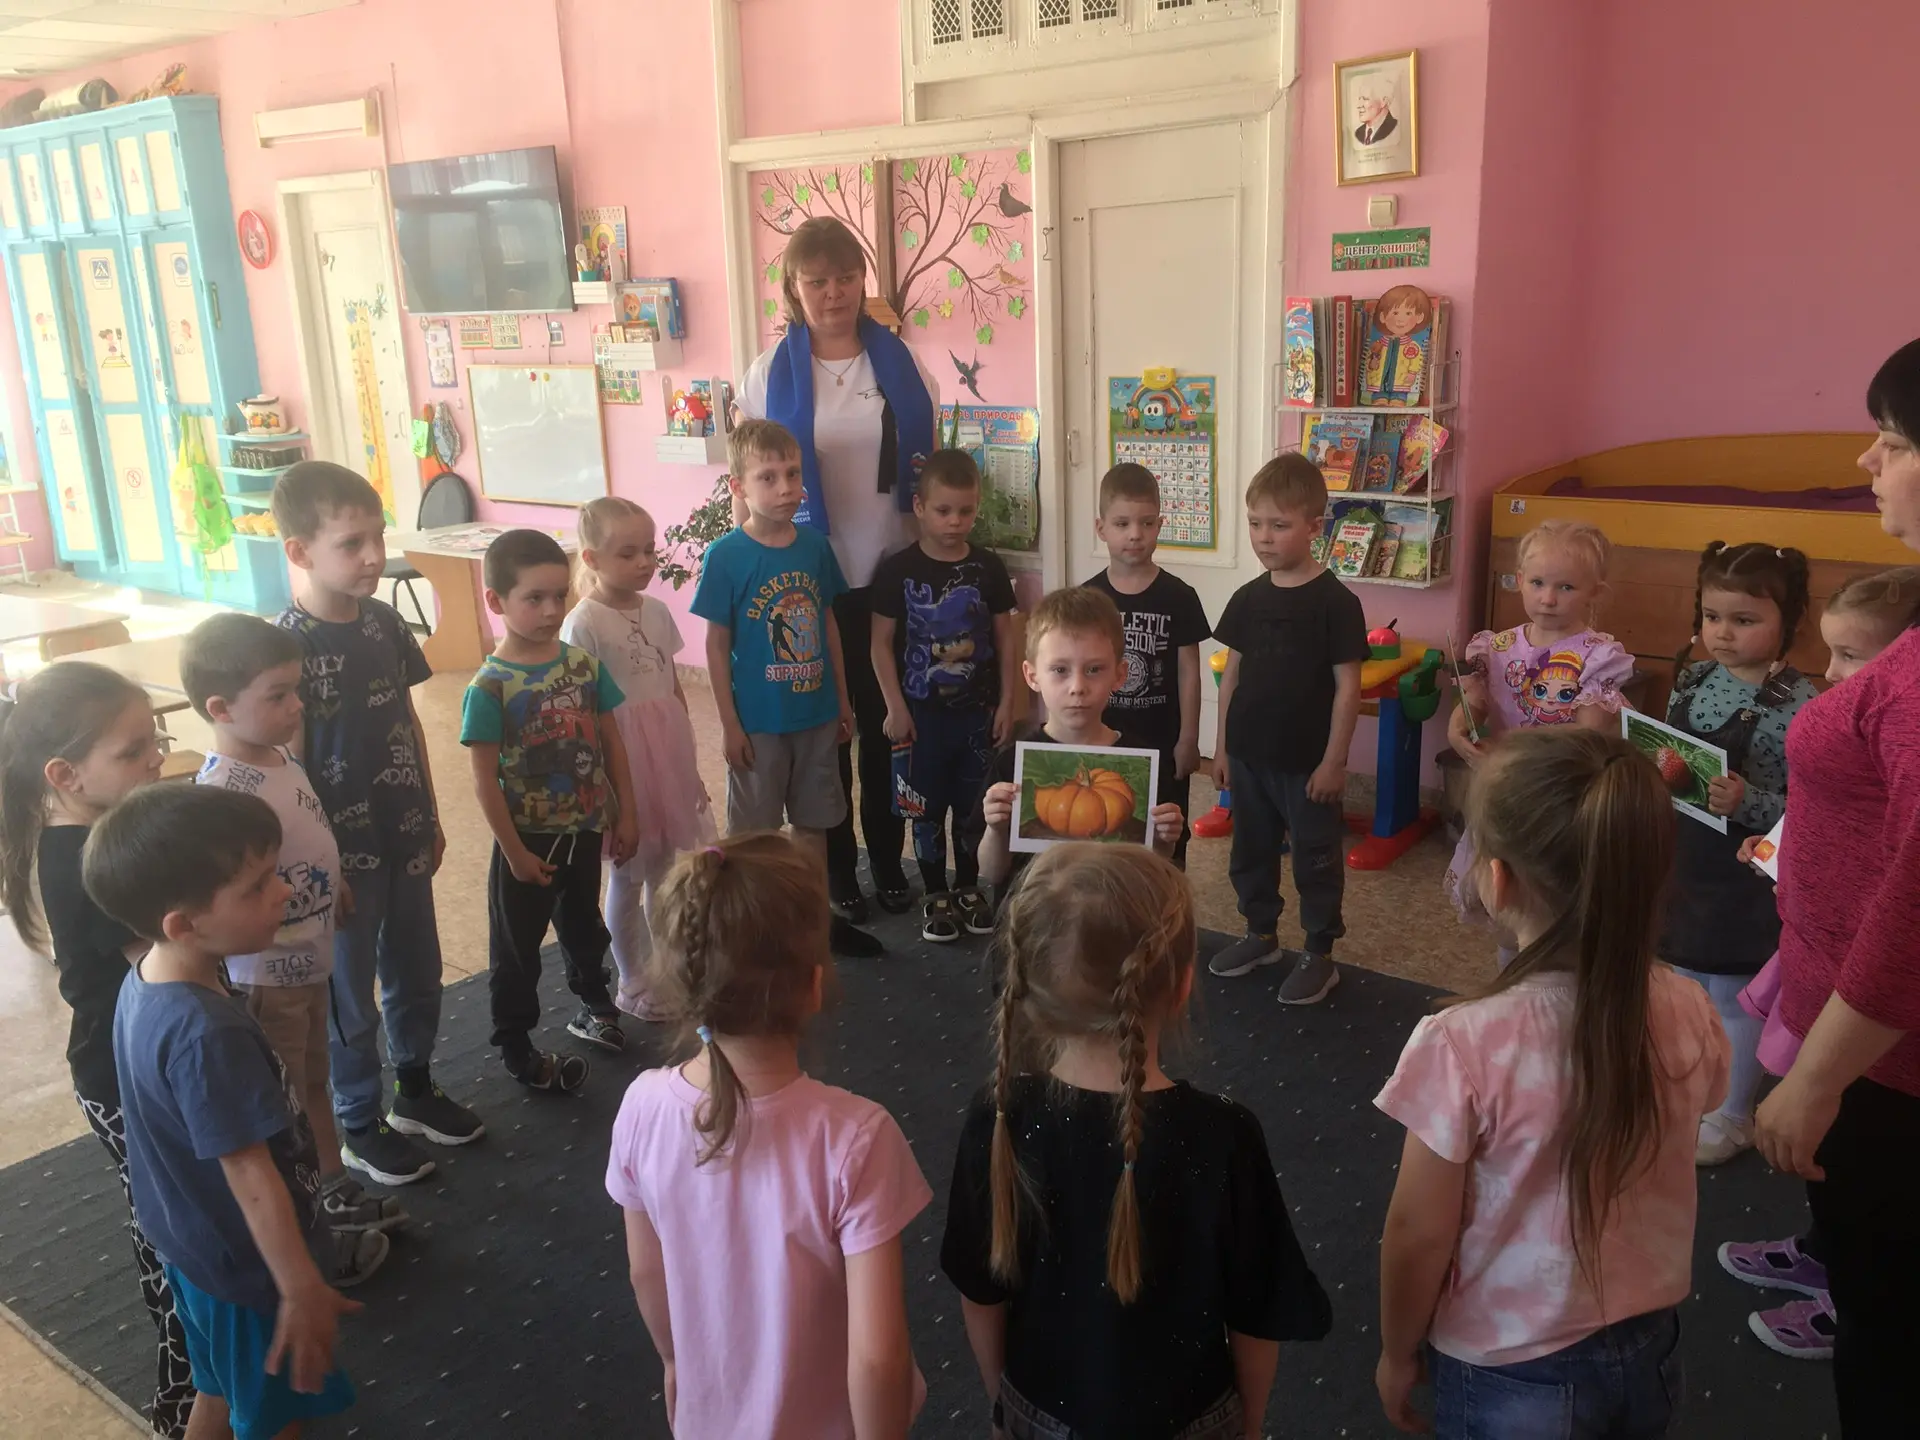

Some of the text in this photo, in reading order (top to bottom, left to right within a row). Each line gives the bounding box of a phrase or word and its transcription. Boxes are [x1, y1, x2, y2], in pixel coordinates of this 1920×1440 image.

[1345, 242, 1416, 256] ЦЕНТР КНИГИ
[974, 410, 1024, 421] ПРИРОДЫ
[1119, 611, 1171, 638] LETIC
[1123, 630, 1157, 656] SION
